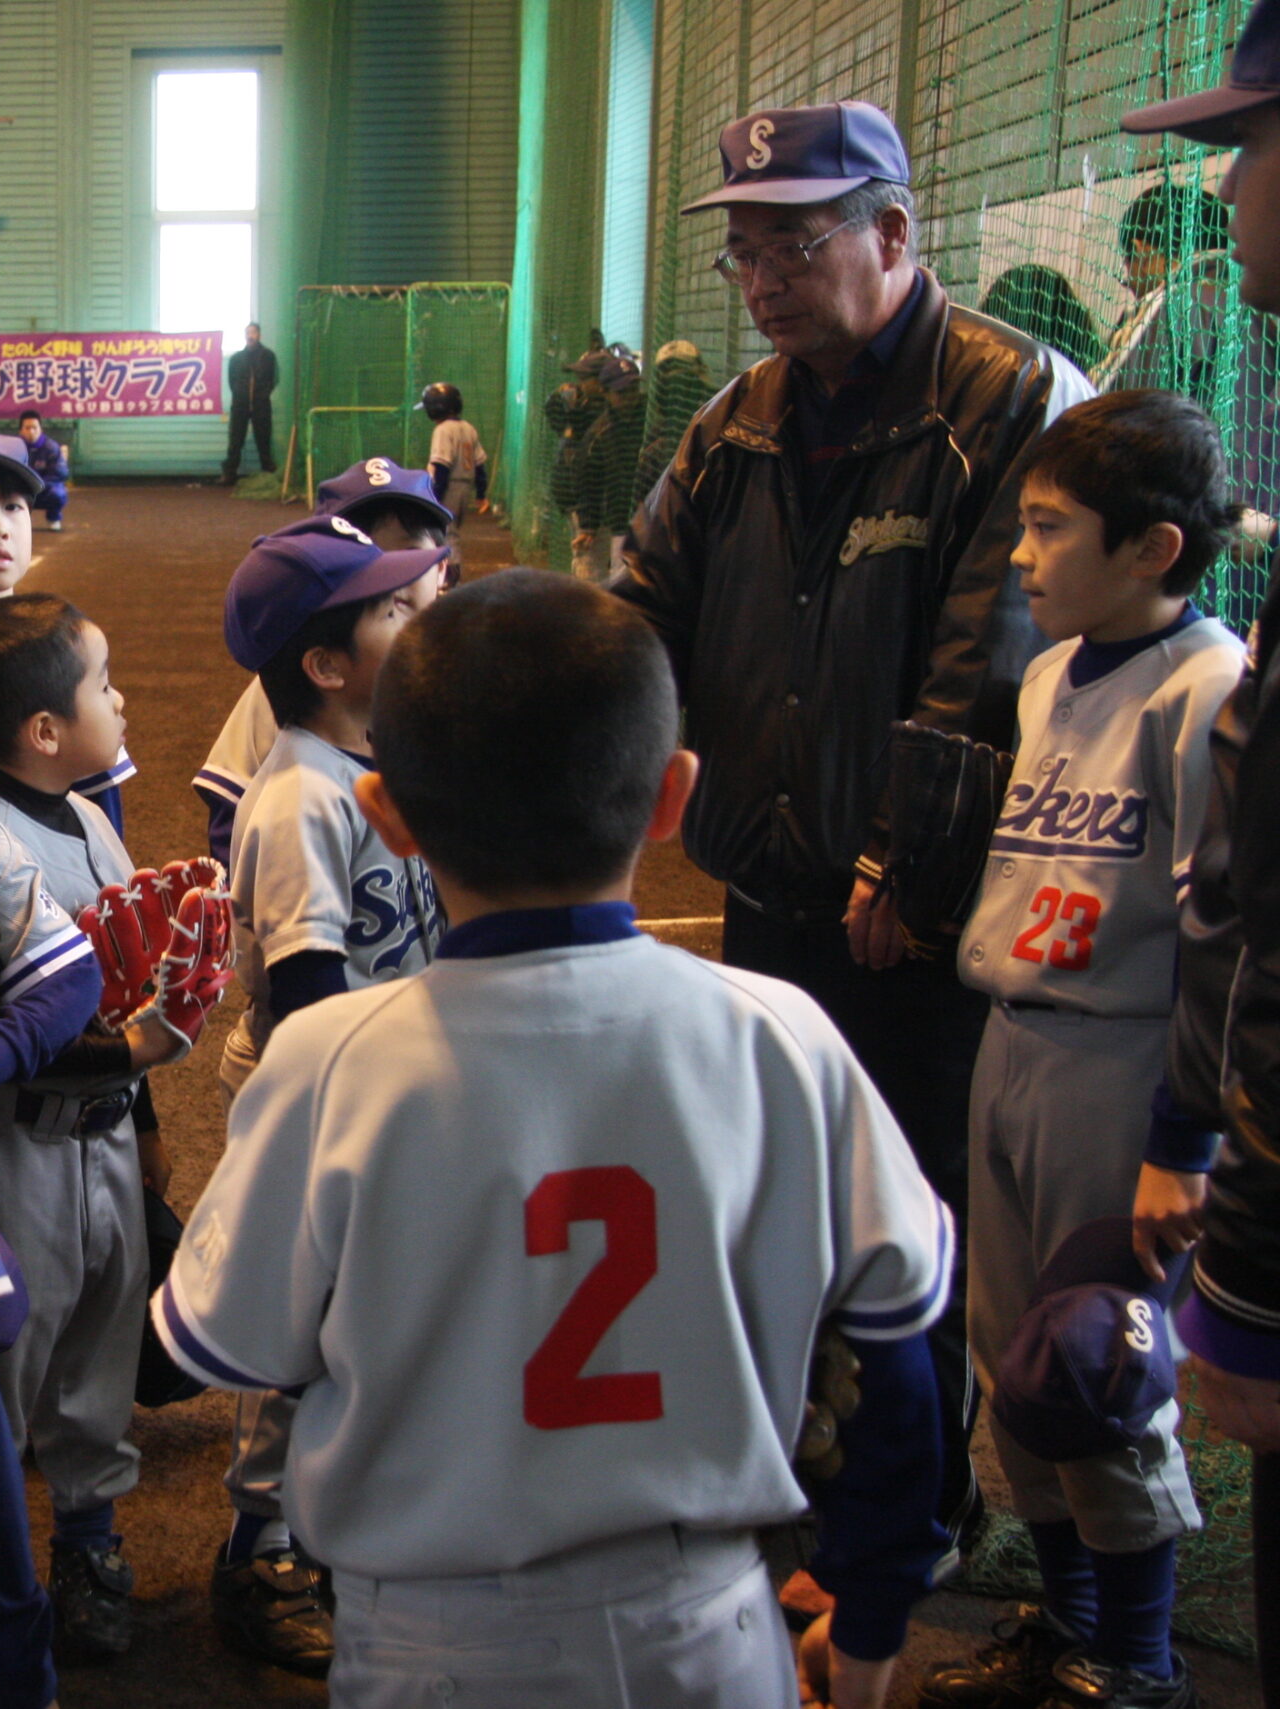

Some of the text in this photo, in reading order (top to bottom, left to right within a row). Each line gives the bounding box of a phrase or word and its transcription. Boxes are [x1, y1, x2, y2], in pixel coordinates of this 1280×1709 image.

[746, 118, 775, 170] S
[365, 457, 391, 487] S
[330, 516, 373, 546] S
[1011, 886, 1101, 971] 23
[523, 1165, 663, 1430] 2
[1124, 1298, 1154, 1353] S
